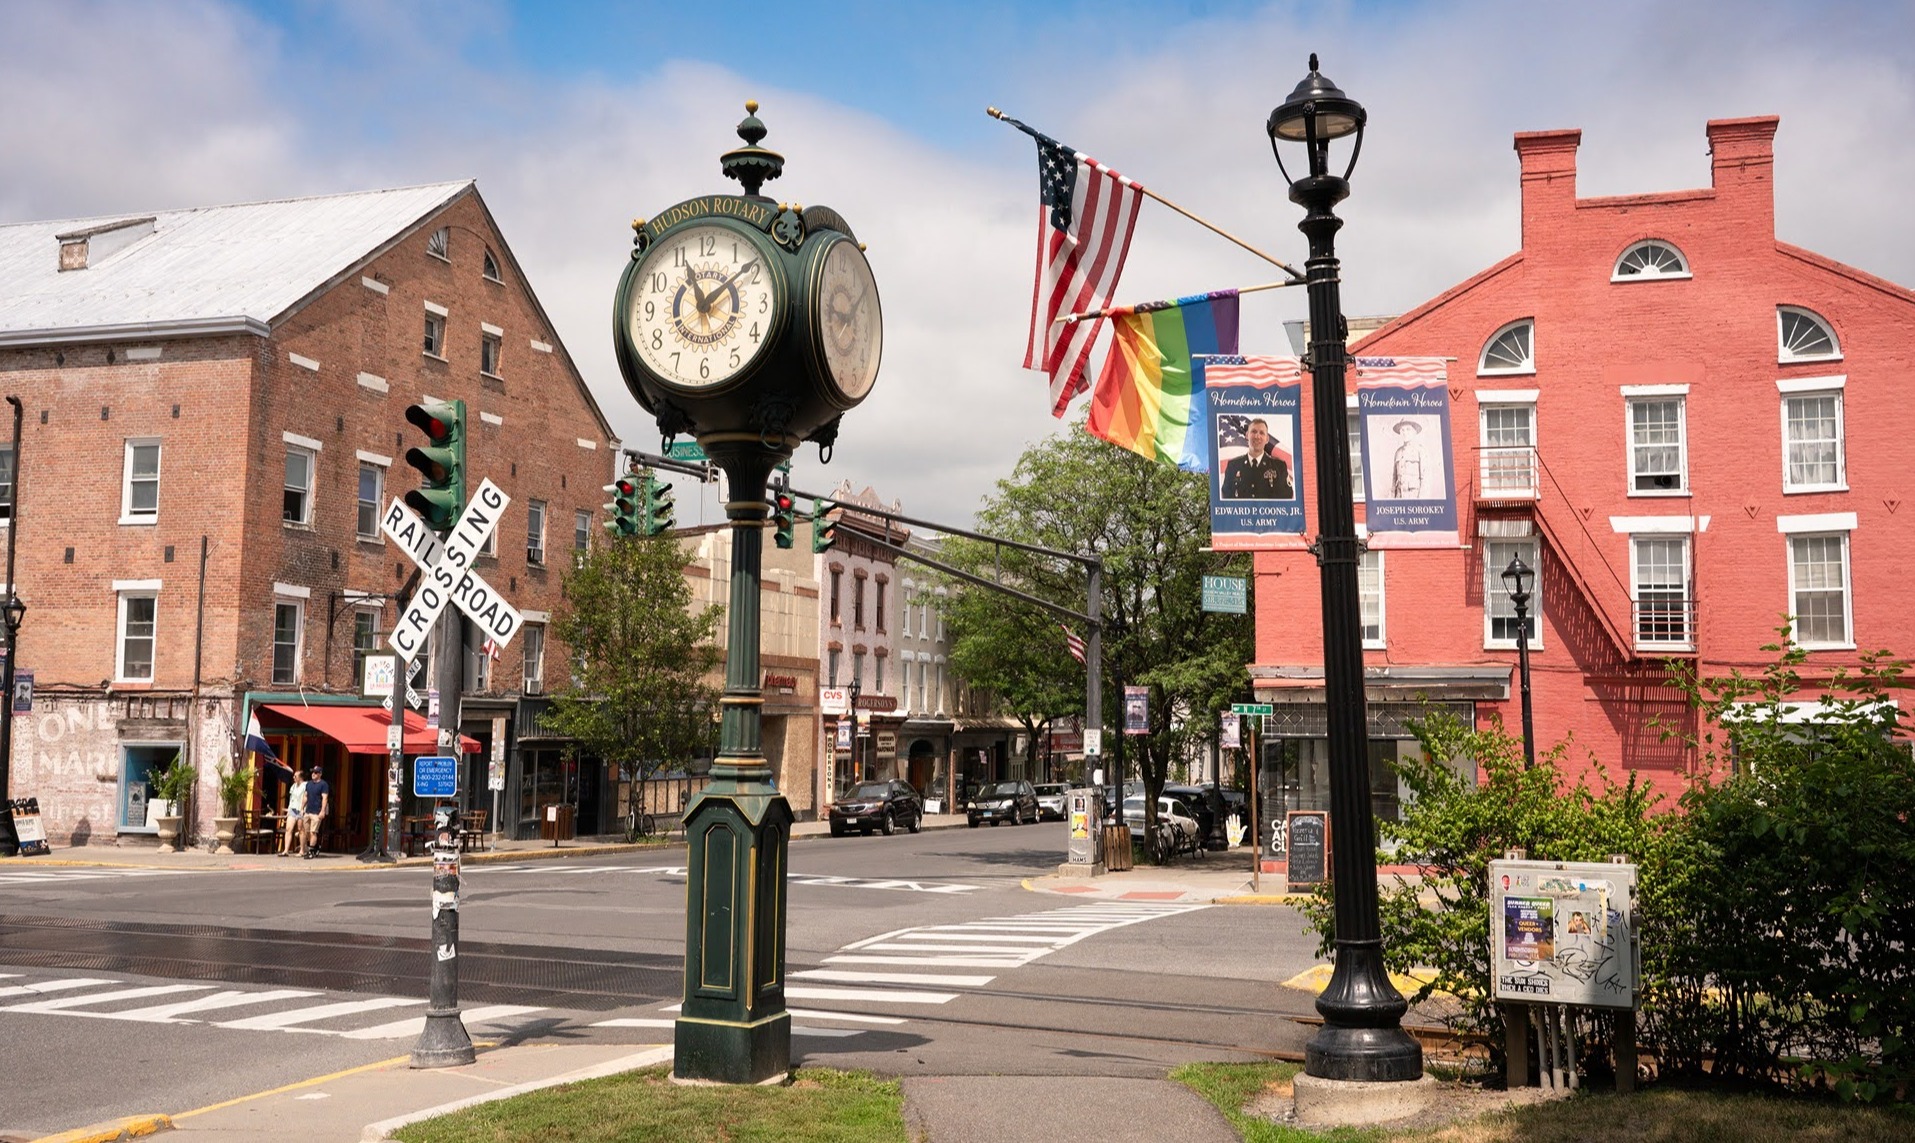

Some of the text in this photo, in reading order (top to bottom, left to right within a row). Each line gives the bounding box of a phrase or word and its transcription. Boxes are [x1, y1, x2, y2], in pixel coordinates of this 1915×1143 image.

[652, 197, 770, 235] HUDSON ROTARY
[674, 246, 687, 268] 11
[699, 235, 717, 257] 12
[732, 242, 739, 264] 1
[651, 271, 668, 294] 10
[693, 271, 724, 281] OTARY
[750, 263, 762, 286] 2
[645, 300, 655, 322] 9
[758, 292, 768, 314] 3
[651, 328, 663, 351] 8
[677, 317, 736, 344] INTERNATIONAL
[749, 321, 760, 344] 4
[669, 351, 681, 374] 7
[699, 357, 710, 379] 6
[729, 345, 741, 369] 5
[1211, 391, 1296, 407] Hometown Heroes
[1361, 391, 1444, 408] Hometown Heroes
[1215, 506, 1250, 516] EDWARD
[1258, 506, 1289, 517] COONS,
[1290, 506, 1302, 516] JR.
[1376, 505, 1445, 515] JOSEPH SOROKEY
[1240, 518, 1278, 527] U.S. ARMY
[1393, 517, 1430, 526] U.S. ARMY
[386, 505, 514, 637] RAIL ROAD
[397, 487, 502, 651] CROSSING
[1204, 577, 1245, 592] HOUSE
[823, 691, 843, 699] CVS
[1294, 834, 1308, 842] Grill
[1502, 976, 1513, 984] THE
[1514, 976, 1526, 985] SUN
